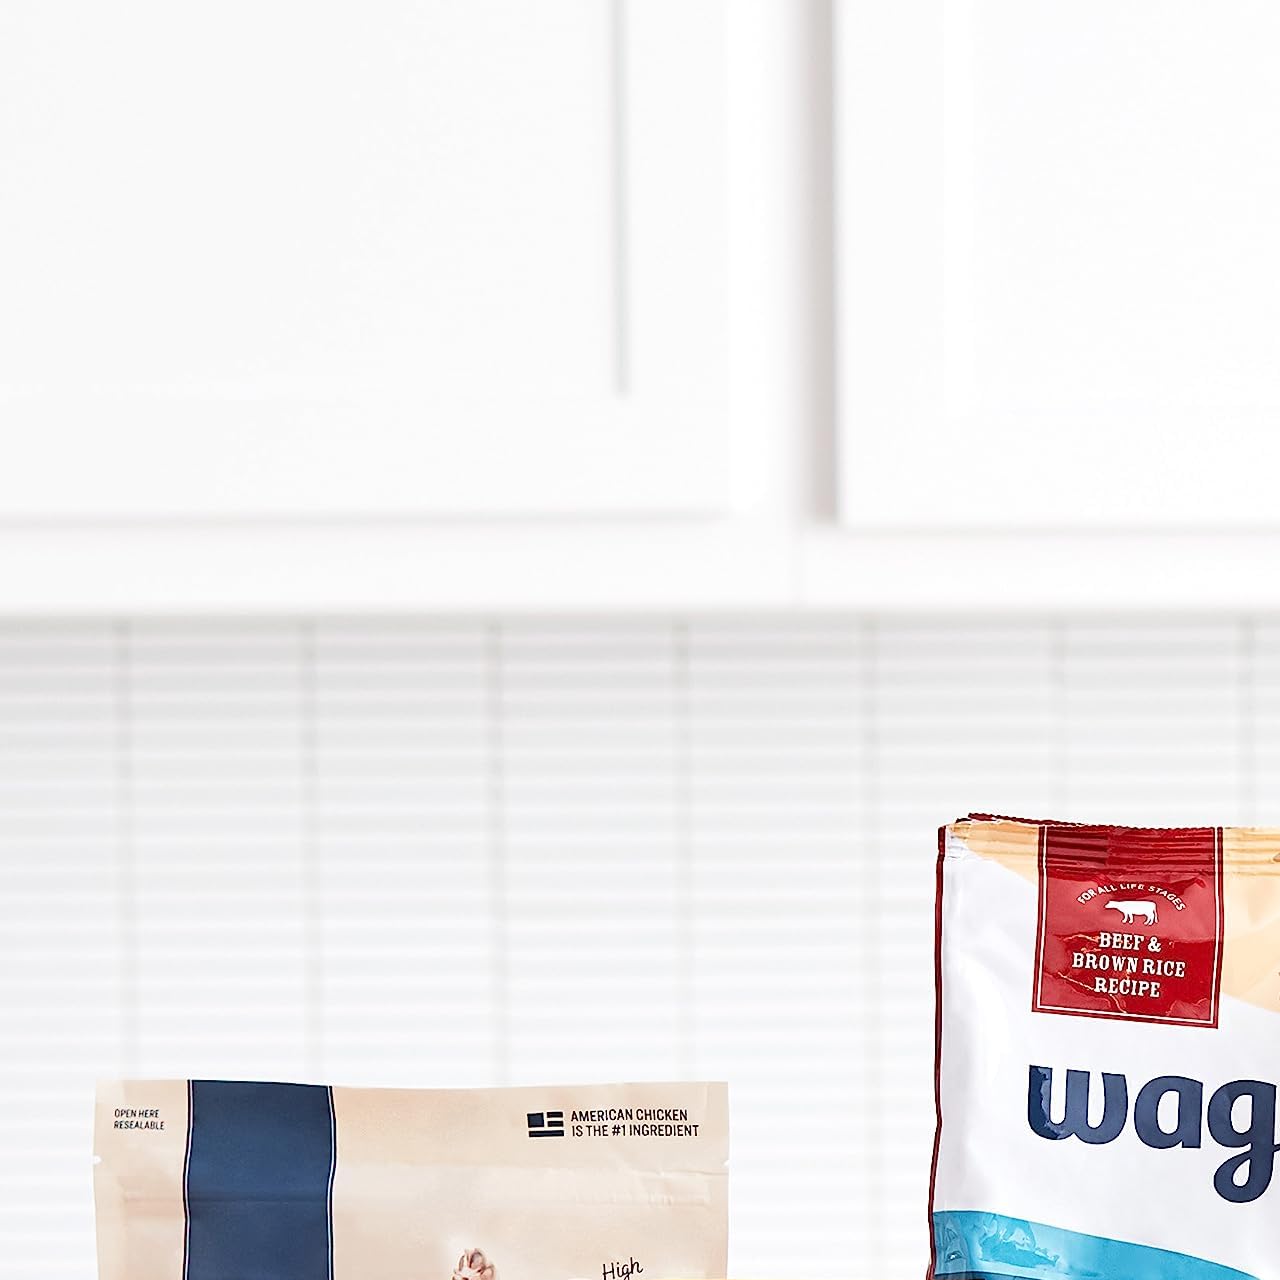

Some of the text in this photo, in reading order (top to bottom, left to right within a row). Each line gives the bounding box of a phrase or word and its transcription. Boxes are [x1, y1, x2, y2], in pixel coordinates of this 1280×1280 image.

[1077, 888, 1097, 904] FOR
[1097, 885, 1117, 894] ALL
[1148, 885, 1186, 911] STAGES
[1099, 932, 1161, 952] BEEF &
[1072, 952, 1185, 977] BROWN RICE
[1094, 977, 1160, 997] RECIPE
[115, 1109, 159, 1118] OPEN HERE
[571, 1109, 687, 1121] AMERICAN CHICKEN
[114, 1121, 164, 1130] RESEALABLE
[572, 1125, 699, 1136] IS THE #1 INGREDIENT
